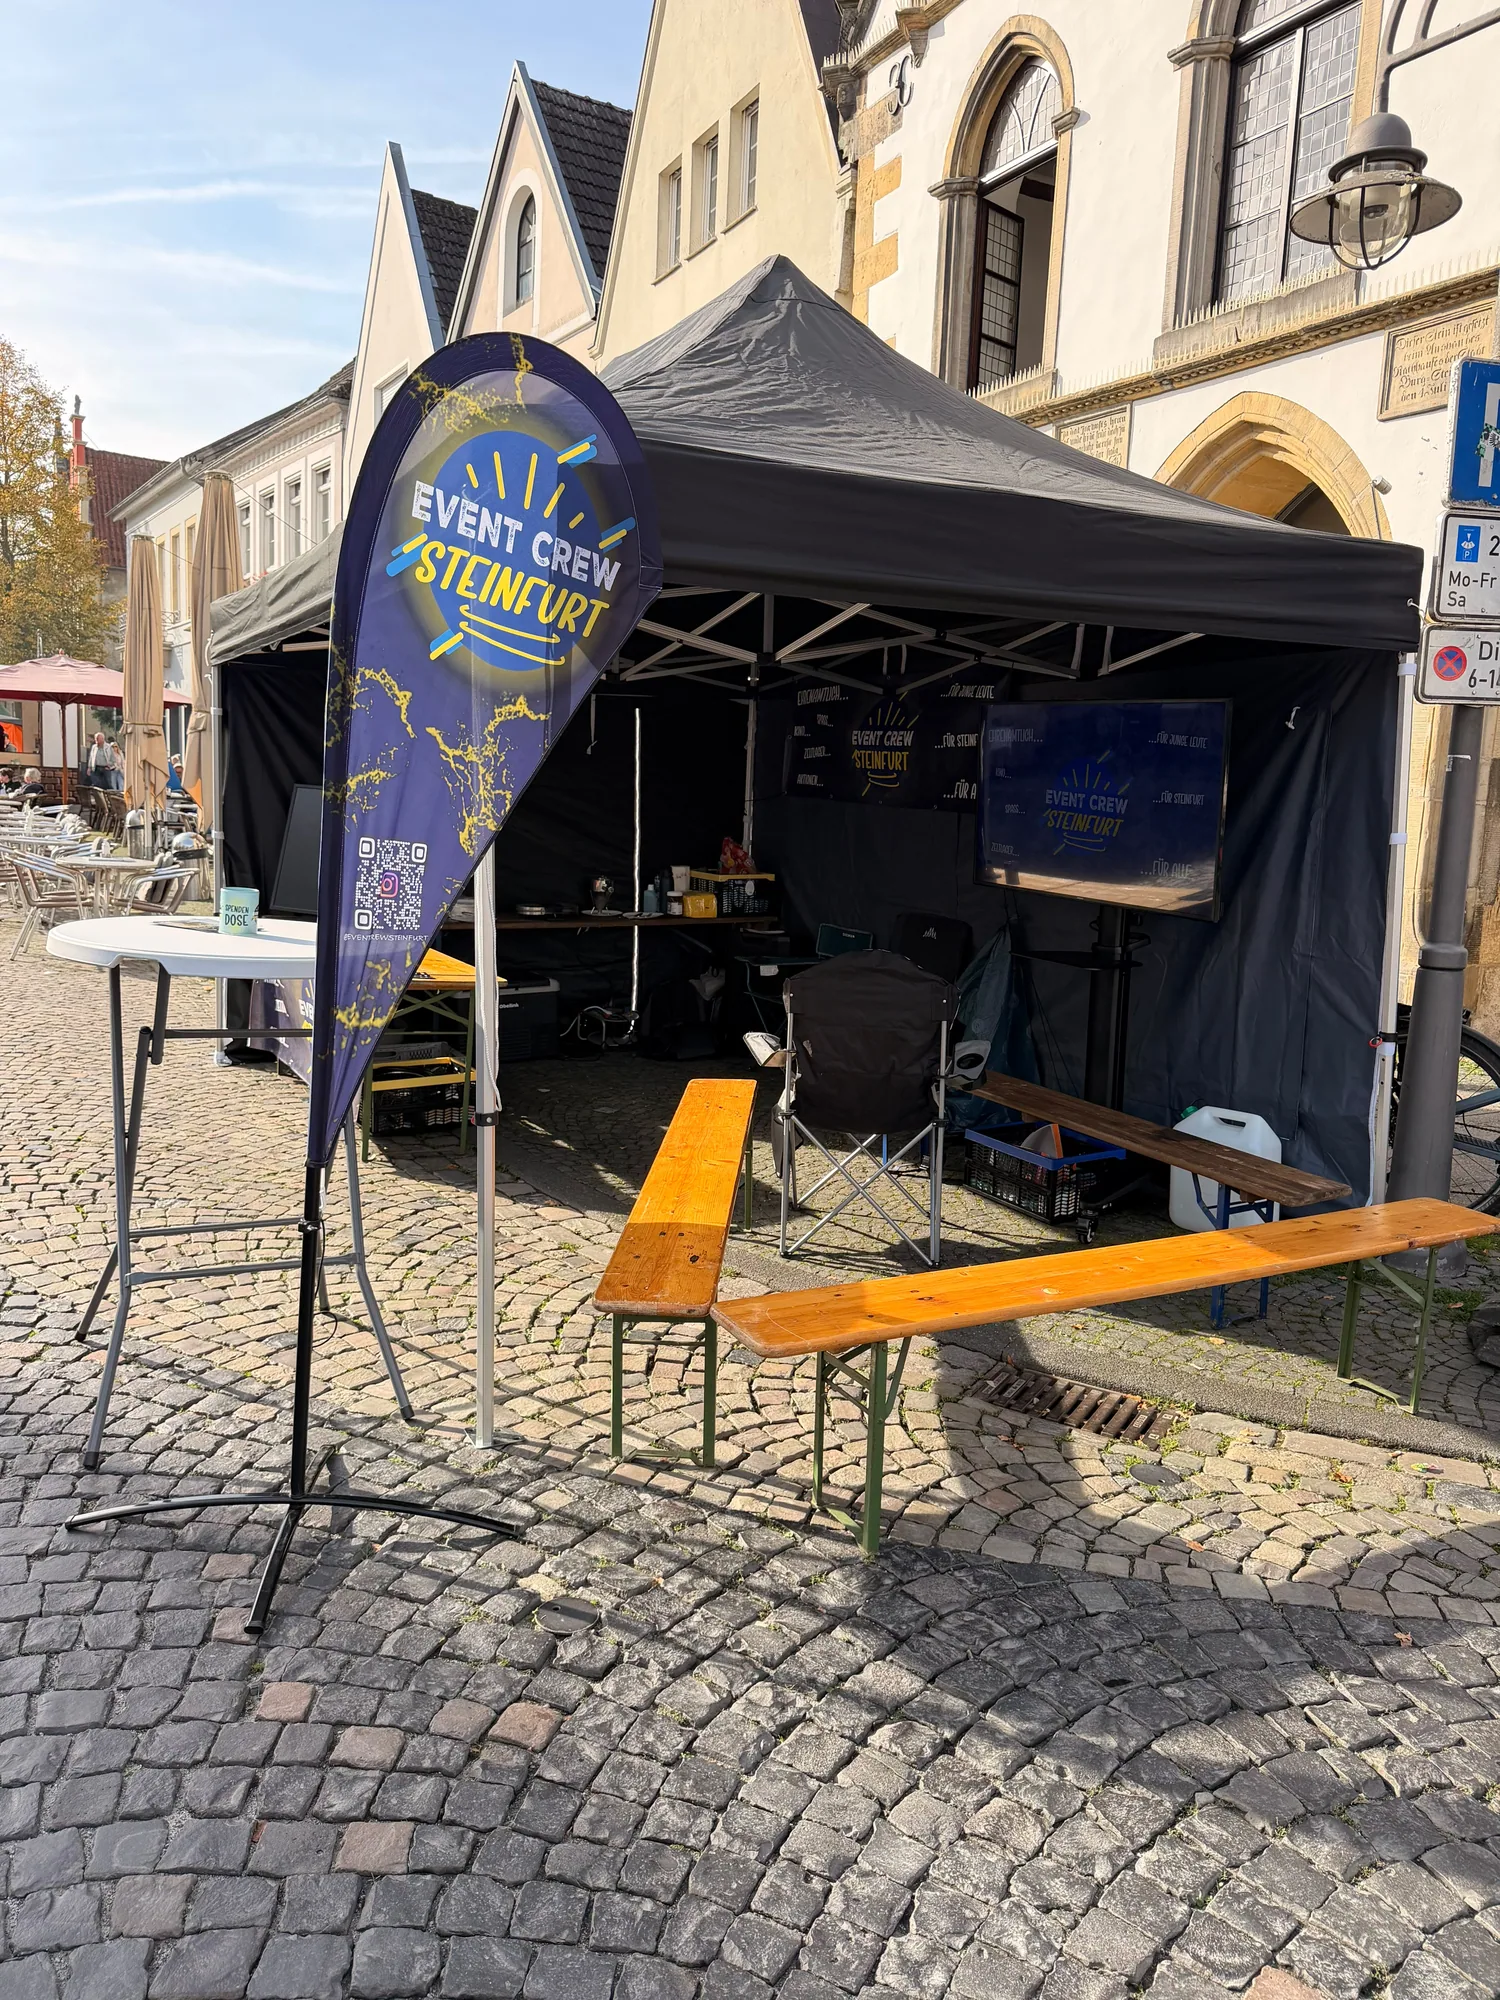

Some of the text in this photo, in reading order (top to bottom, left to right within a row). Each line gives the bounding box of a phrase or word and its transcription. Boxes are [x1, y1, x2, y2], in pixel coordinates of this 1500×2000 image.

[412, 481, 622, 591] EVENT CREW
[1449, 571, 1497, 588] Mo-Fr
[415, 541, 610, 638] STEINFURT
[1447, 591, 1466, 607] Sa
[1479, 641, 1500, 661] Di
[852, 731, 914, 746] EVENT CREW
[956, 734, 978, 747] STEINF
[855, 750, 909, 771] STEINFURT
[1045, 789, 1128, 814] EVENT CREW
[1047, 810, 1124, 837] STEINFURT
[225, 904, 250, 913] SPENDEN
[225, 914, 249, 926] DOSE
